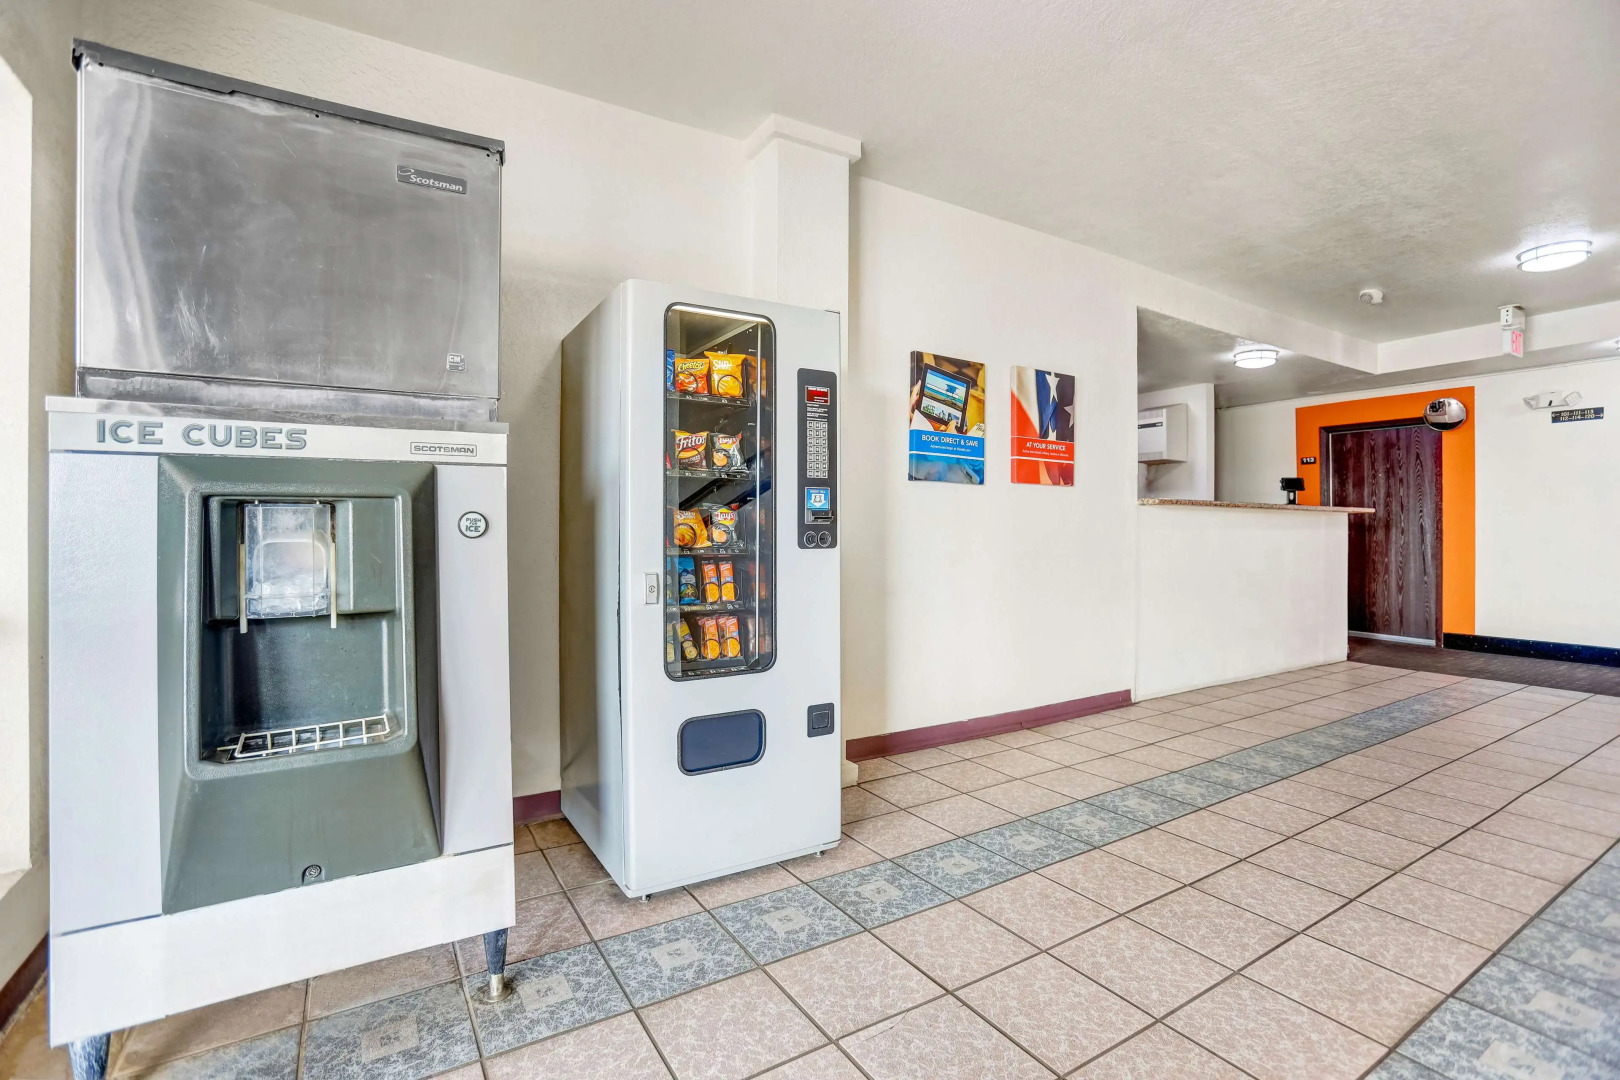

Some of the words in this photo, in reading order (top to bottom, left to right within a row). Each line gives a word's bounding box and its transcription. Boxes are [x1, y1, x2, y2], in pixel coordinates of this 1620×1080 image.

[409, 174, 463, 191] Scotsman
[96, 418, 163, 445] ICE
[181, 423, 307, 450] CUBES
[921, 434, 940, 443] BOOK
[940, 436, 960, 445] DIRECT
[965, 440, 979, 448] SAVE
[413, 445, 475, 454] SCOTSMAN
[676, 434, 705, 451] Fritos
[1047, 443, 1066, 451] SERVICE
[465, 525, 481, 533] ICE
